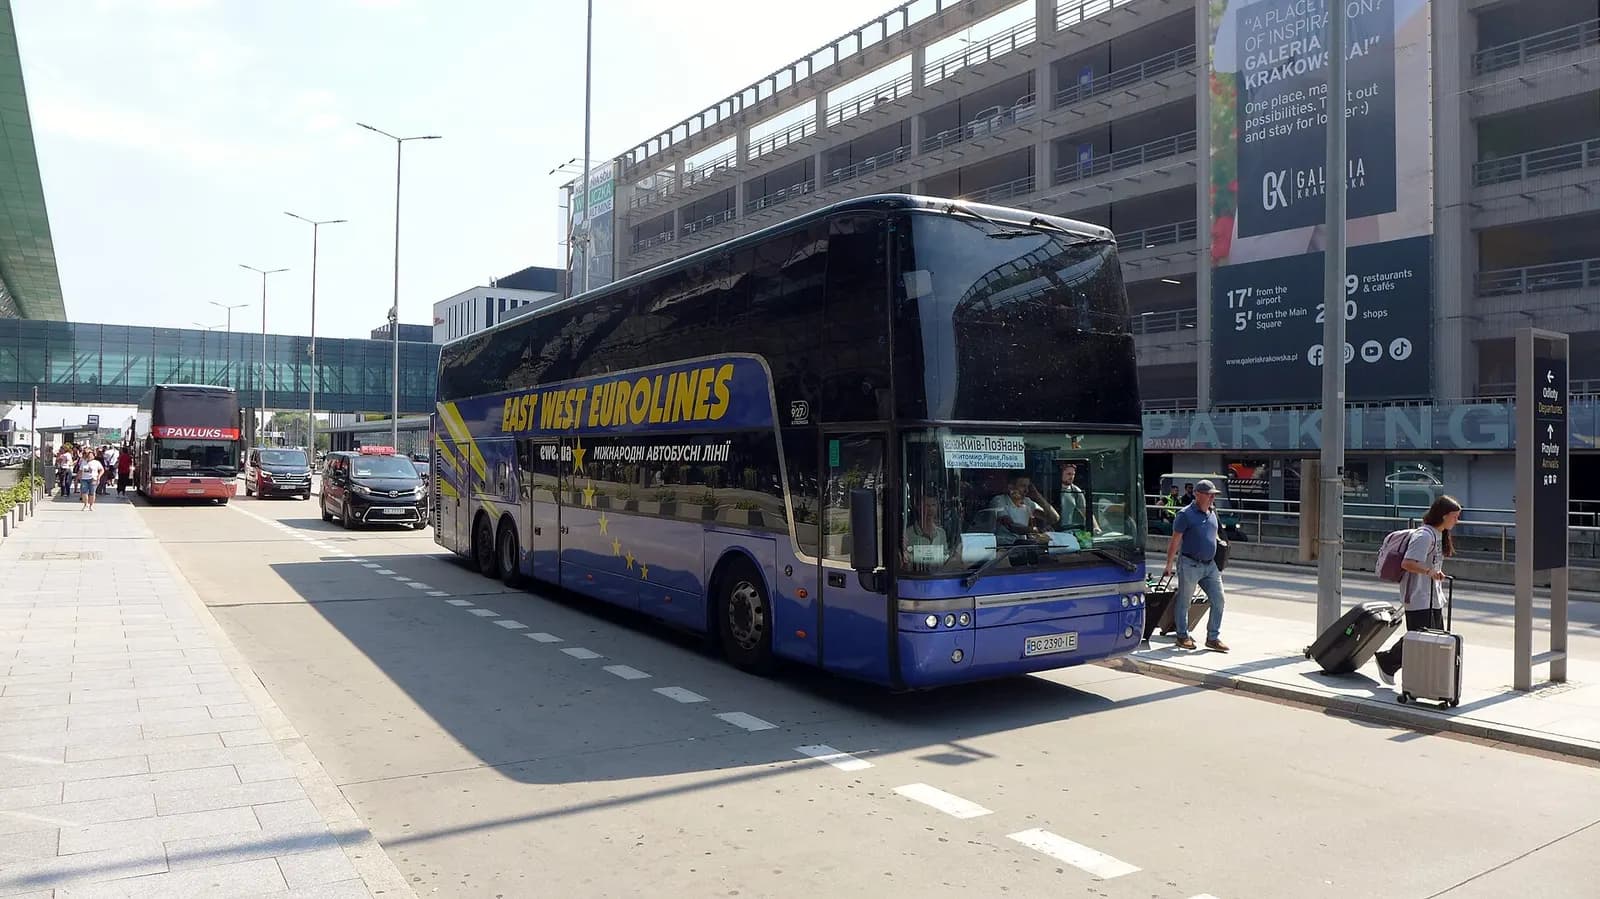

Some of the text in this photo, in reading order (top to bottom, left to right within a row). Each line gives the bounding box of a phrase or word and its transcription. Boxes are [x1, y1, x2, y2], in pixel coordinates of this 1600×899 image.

[1266, 0, 1316, 27] PLACE
[1245, 33, 1265, 52] OF
[1245, 35, 1321, 71] GALERIA
[1245, 102, 1268, 114] One
[1271, 90, 1306, 109] place,
[1245, 102, 1317, 131] possibilities.
[1356, 83, 1379, 99] out
[1245, 128, 1266, 143] and
[1269, 122, 1293, 138] stay
[1297, 117, 1314, 131] for
[1317, 106, 1356, 125] loer
[1297, 158, 1366, 188] GALIA
[1363, 269, 1413, 283] restaurants
[1256, 287, 1274, 296] from
[1275, 285, 1288, 295] the
[1363, 281, 1395, 293] & cafés
[1256, 296, 1281, 306] airport
[1256, 311, 1274, 321] from
[1275, 309, 1288, 319] the
[1289, 307, 1307, 317] Main
[1315, 300, 1388, 324] 20 shops
[1256, 320, 1282, 330] Square
[1226, 353, 1298, 366] www.galeriakrakowska.pl
[502, 364, 734, 432] EAST WEST EUROLINES
[167, 427, 221, 438] PAVLUKS
[1142, 404, 1509, 449] PARKING
[593, 440, 732, 462] МІЖНАРОДНІ АВТОБУСНІ ЛІНІЇ
[961, 436, 1025, 451] Київ-Познань
